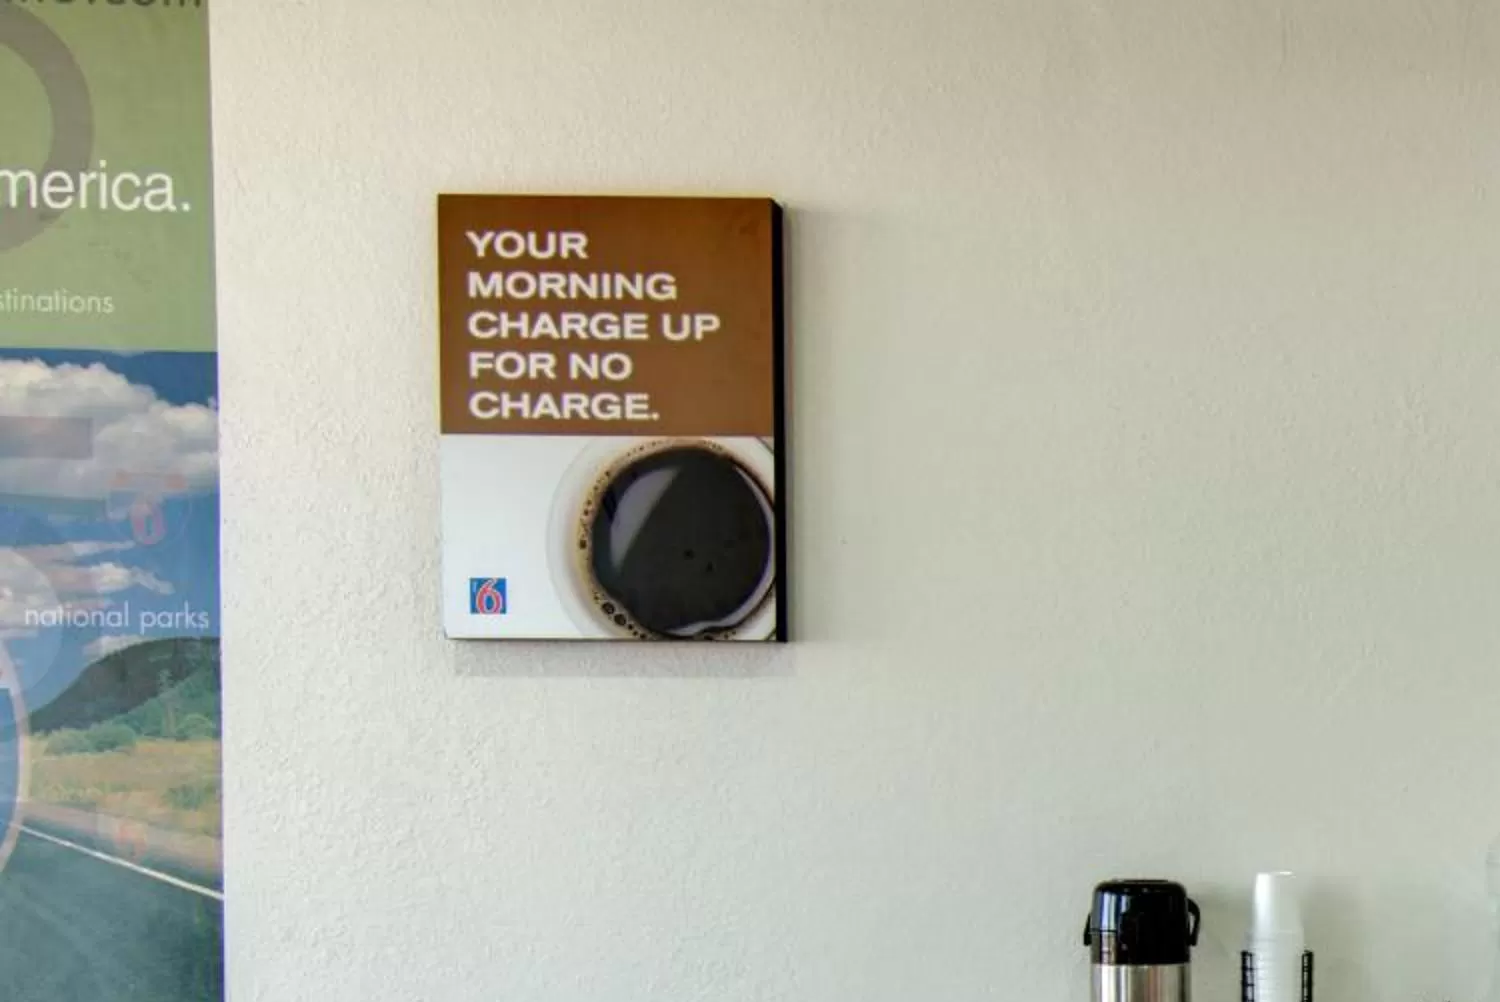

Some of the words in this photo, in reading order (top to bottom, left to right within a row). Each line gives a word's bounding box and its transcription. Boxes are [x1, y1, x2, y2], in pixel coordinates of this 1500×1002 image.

[0, 159, 192, 212] merica.
[466, 230, 589, 259] YOUR
[467, 271, 678, 301] MORNING
[467, 311, 649, 340] CHARGE
[661, 313, 721, 340] UP
[469, 351, 556, 380] FOR
[569, 352, 633, 380] NO
[468, 391, 661, 420] CHARGE.
[24, 600, 130, 627] national
[139, 600, 209, 635] parks
